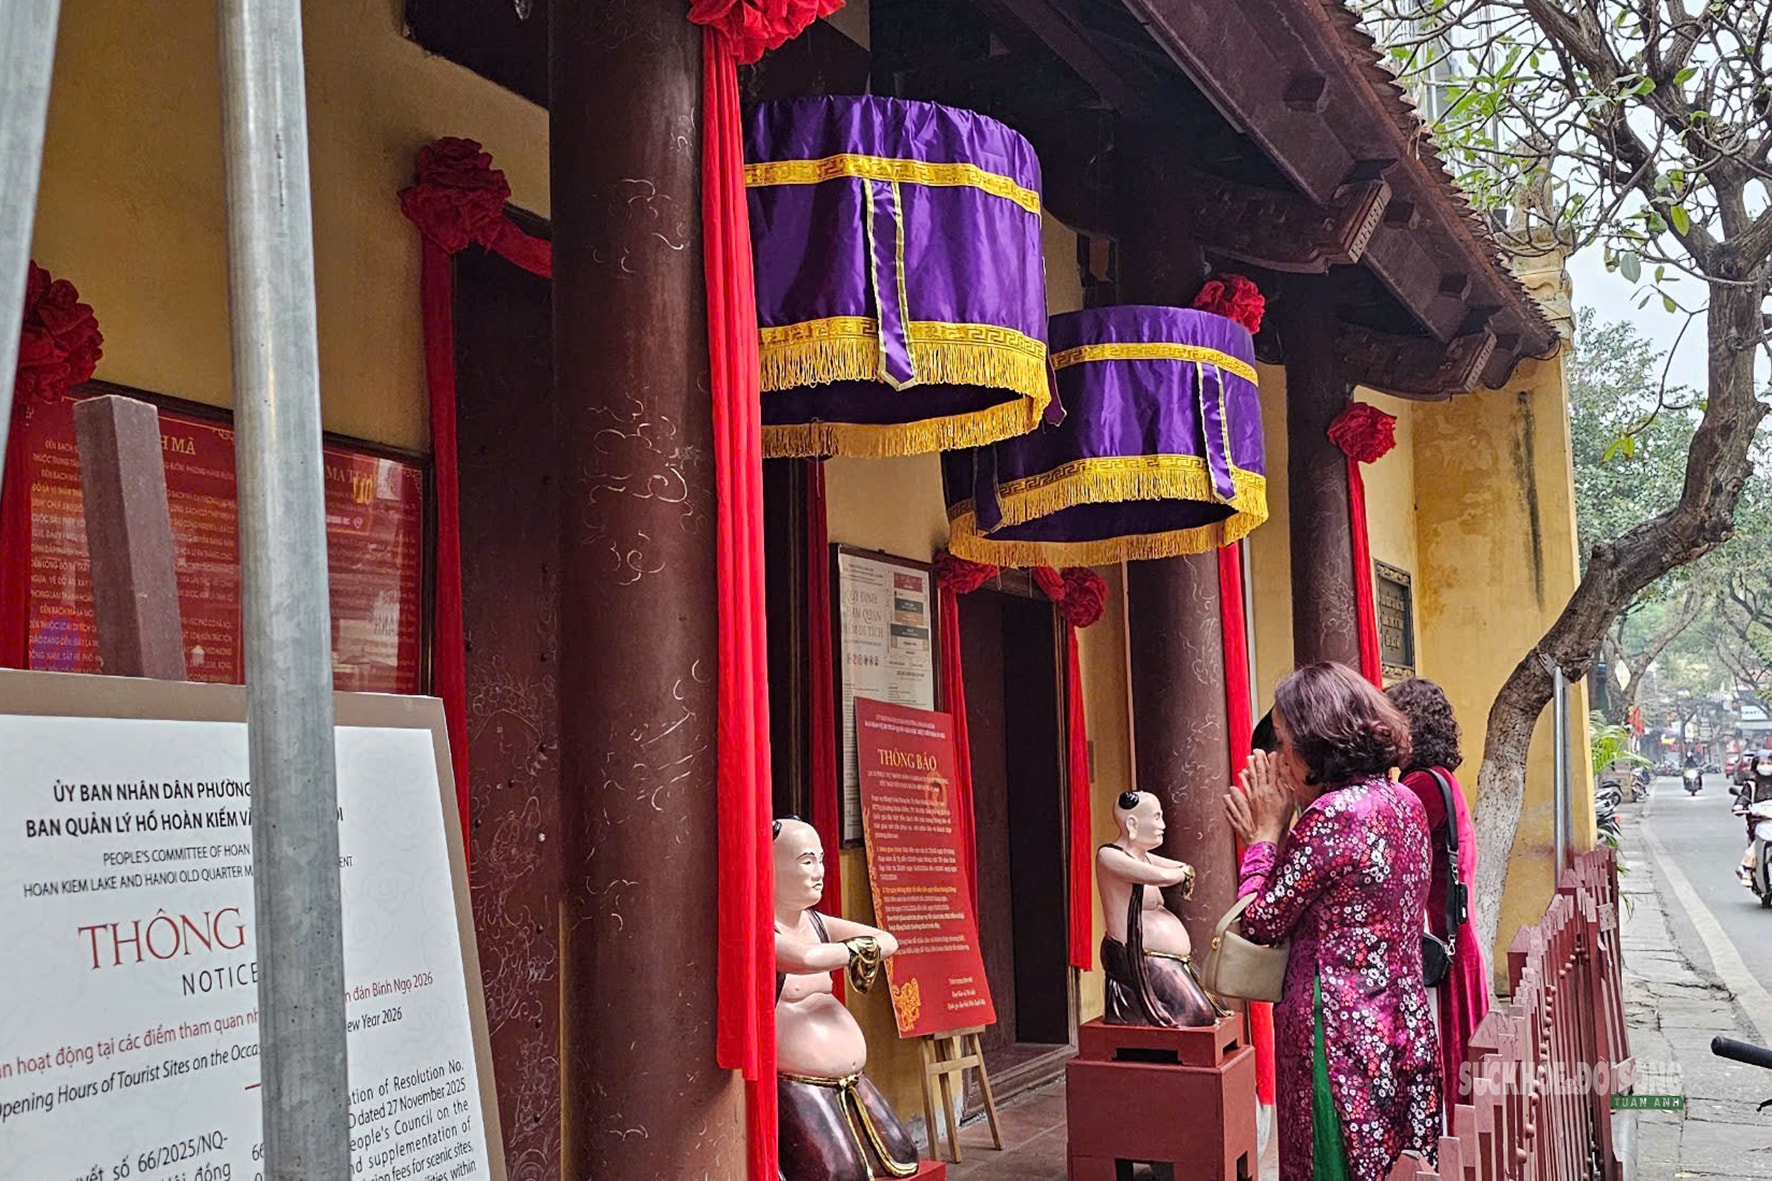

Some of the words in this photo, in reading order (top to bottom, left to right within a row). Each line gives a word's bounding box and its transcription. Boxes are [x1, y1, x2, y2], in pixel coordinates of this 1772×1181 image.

[877, 747, 915, 768] THÔNG
[917, 751, 937, 771] BÁO
[53, 779, 75, 802] ỦY
[80, 784, 112, 802] BAN
[117, 780, 159, 800] NHÂN
[163, 780, 194, 799] DÂN
[26, 818, 61, 838] BAN
[65, 811, 112, 836] QUẢN
[116, 812, 132, 833] LÝ
[162, 810, 201, 830] HOÀN
[206, 806, 238, 828] KIẾM
[103, 850, 151, 866] PEOPLE'S
[152, 846, 208, 863] COMMITTEE
[210, 845, 223, 858] OF
[224, 844, 250, 857] HOAN
[24, 881, 58, 898] HOAN
[61, 878, 88, 893] KIEM
[90, 875, 118, 891] LAKE
[119, 874, 143, 889] AND
[145, 871, 178, 887] HANOI
[179, 869, 199, 884] OLD
[201, 866, 243, 882] QUARTER
[77, 907, 246, 969] THÔNG
[182, 962, 259, 996] NOTICE
[353, 985, 370, 1001] đán
[393, 978, 412, 995] Ngọ
[413, 971, 433, 988] 2026
[347, 1019, 361, 1033] ew
[361, 1013, 380, 1030] Year
[382, 1006, 403, 1024] 2026
[17, 1052, 52, 1076] hoạt
[56, 1046, 94, 1069] động
[98, 1038, 115, 1060] tại
[118, 1033, 141, 1052] các
[144, 1023, 177, 1046] điểm
[179, 1020, 212, 1039] tham
[214, 1016, 244, 1038] quan
[0, 1091, 53, 1123] pening
[58, 1081, 98, 1104] Hours
[101, 1073, 116, 1093] of
[117, 1065, 160, 1089] Tourist
[162, 1057, 190, 1078] Sites
[193, 1056, 208, 1070] on
[210, 1048, 229, 1067] the
[379, 1078, 389, 1096] of
[393, 1064, 445, 1092] Resolution
[448, 1059, 464, 1075] No.
[358, 1102, 386, 1126] dated
[387, 1099, 398, 1116] 27
[400, 1085, 445, 1111] November
[446, 1077, 466, 1096] 2025
[349, 1126, 390, 1155] eople's
[394, 1109, 433, 1135] Council
[437, 1107, 449, 1121] on
[453, 1099, 469, 1115] the
[368, 1124, 458, 1169] supplementation
[461, 1115, 471, 1133] of
[113, 1156, 130, 1181] số
[137, 1130, 228, 1173] 66/2025/NQ-
[392, 1165, 411, 1181] fees
[412, 1156, 425, 1172] for
[426, 1146, 451, 1169] scenic
[450, 1158, 477, 1181] within
